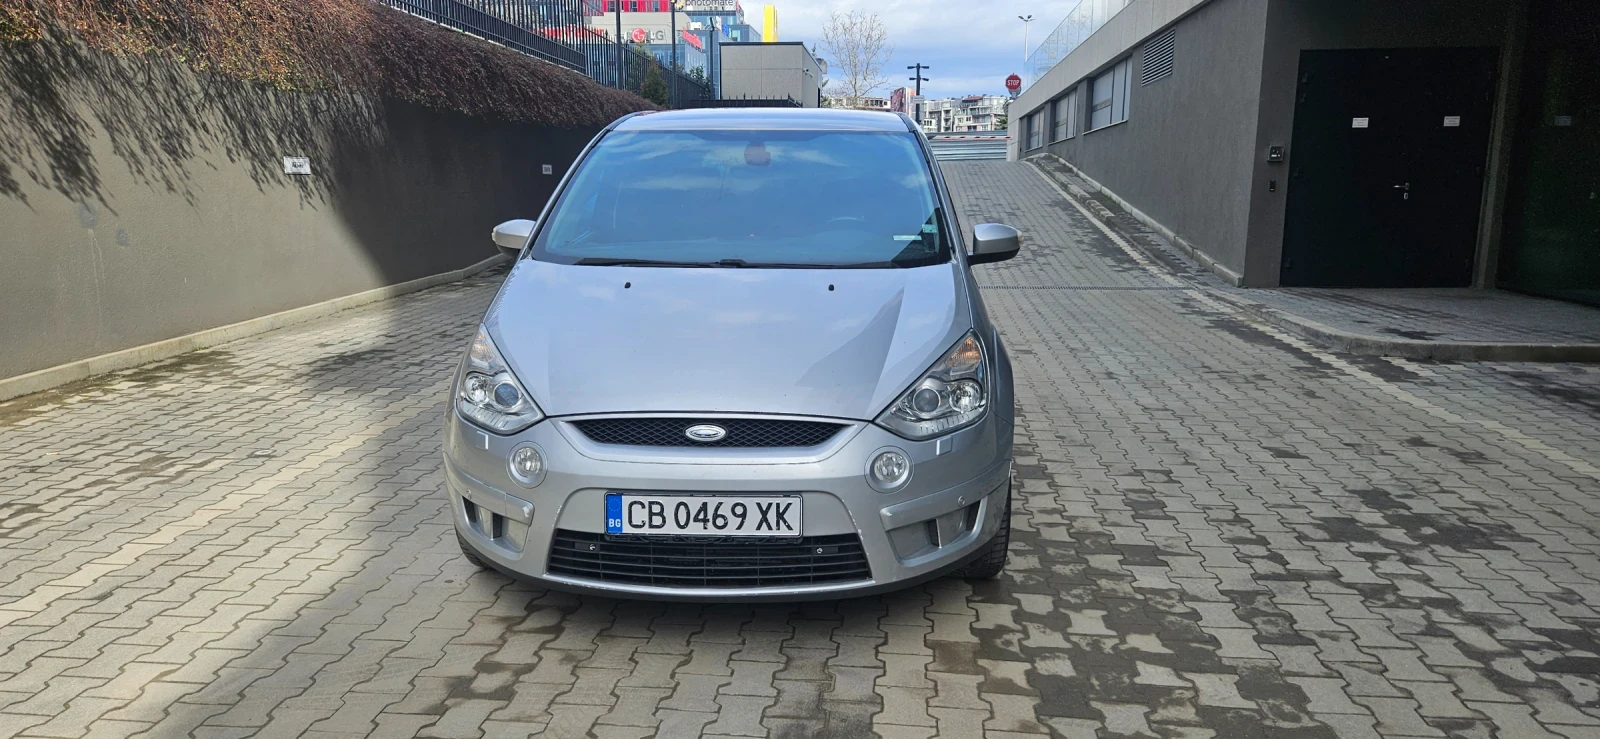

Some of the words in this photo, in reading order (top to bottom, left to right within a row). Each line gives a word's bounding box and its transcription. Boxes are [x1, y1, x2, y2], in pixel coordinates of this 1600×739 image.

[649, 30, 664, 41] LG
[627, 500, 667, 529] CB
[673, 501, 748, 531] 0469
[755, 502, 794, 531] XK
[608, 518, 622, 528] BG
